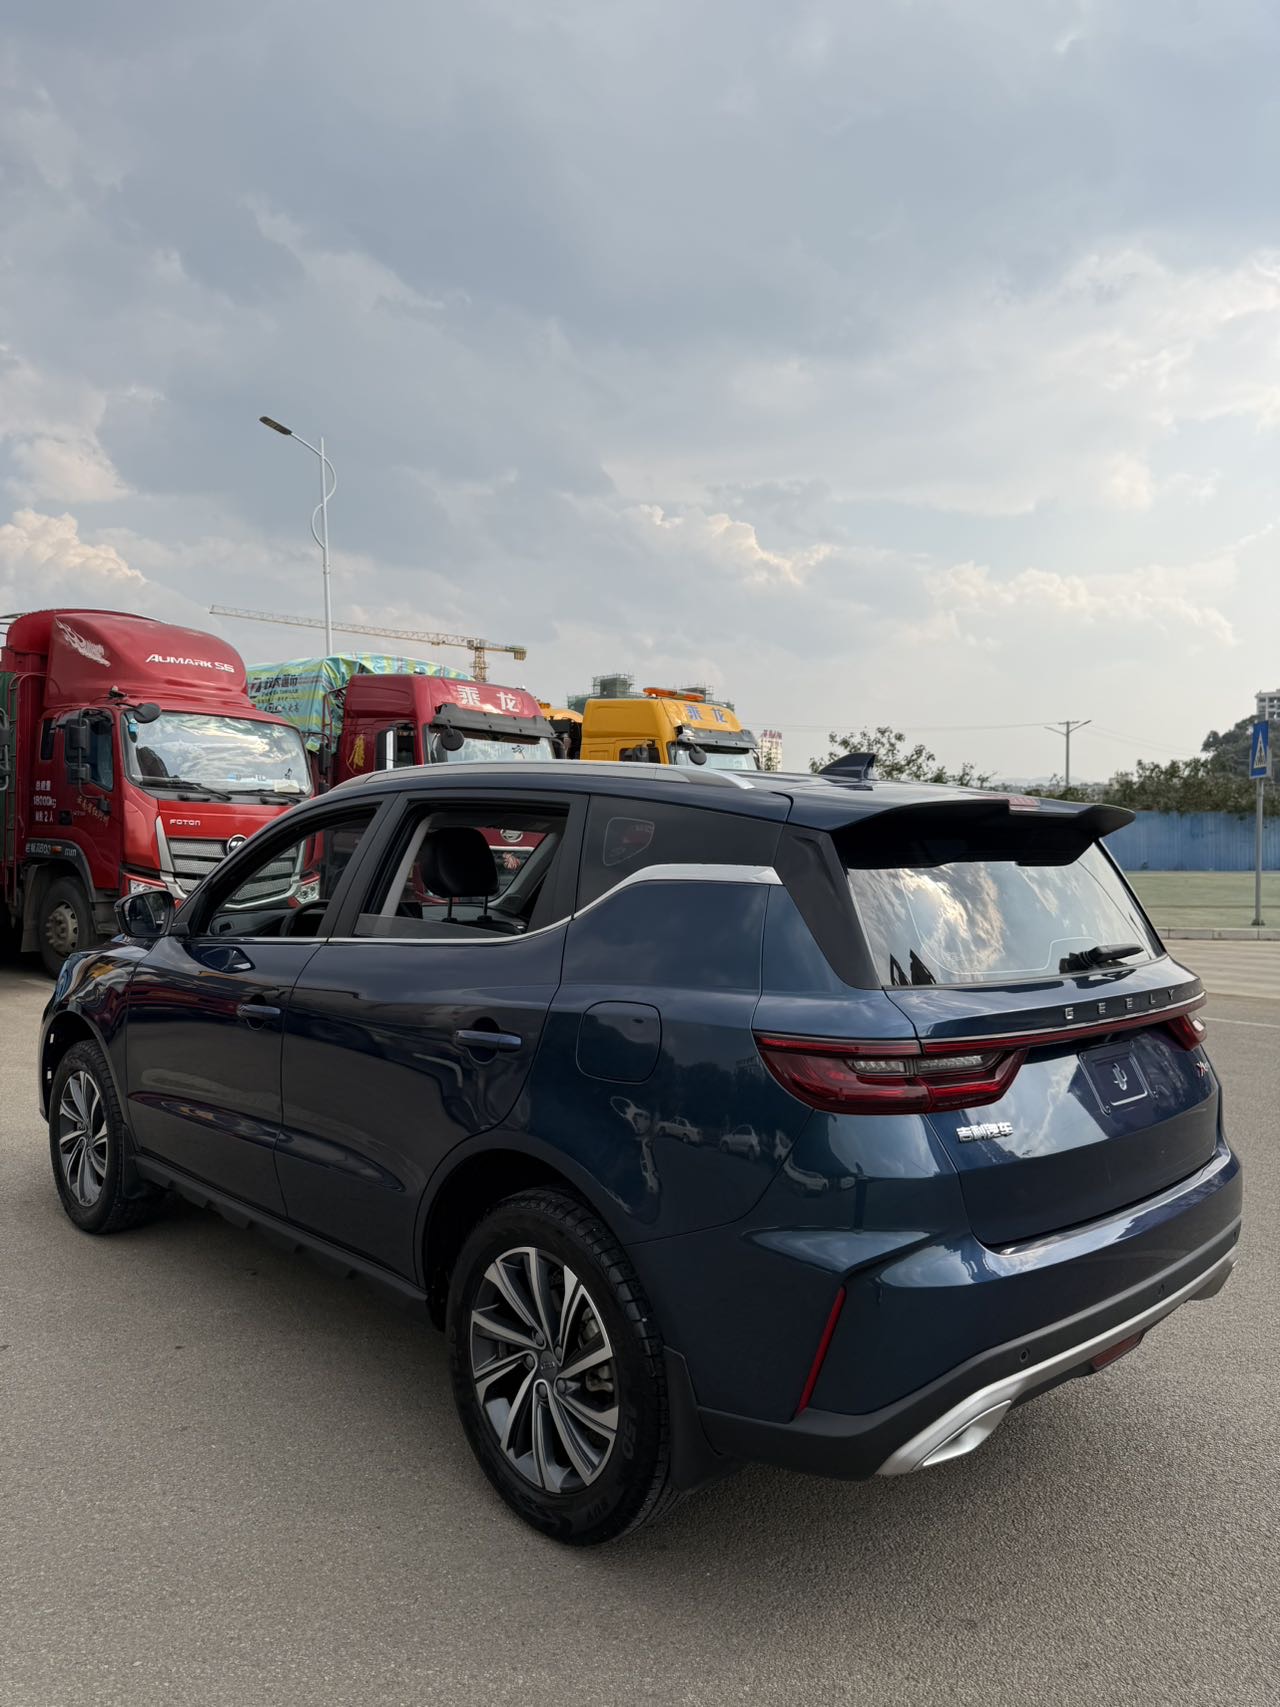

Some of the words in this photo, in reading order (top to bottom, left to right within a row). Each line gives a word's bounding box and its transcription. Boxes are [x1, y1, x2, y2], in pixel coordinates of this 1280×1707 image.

[145, 653, 213, 668] AUMARK
[169, 818, 201, 826] FOTON
[1064, 989, 1174, 1020] GEELY
[956, 1121, 1015, 1143] 吉利汽车
